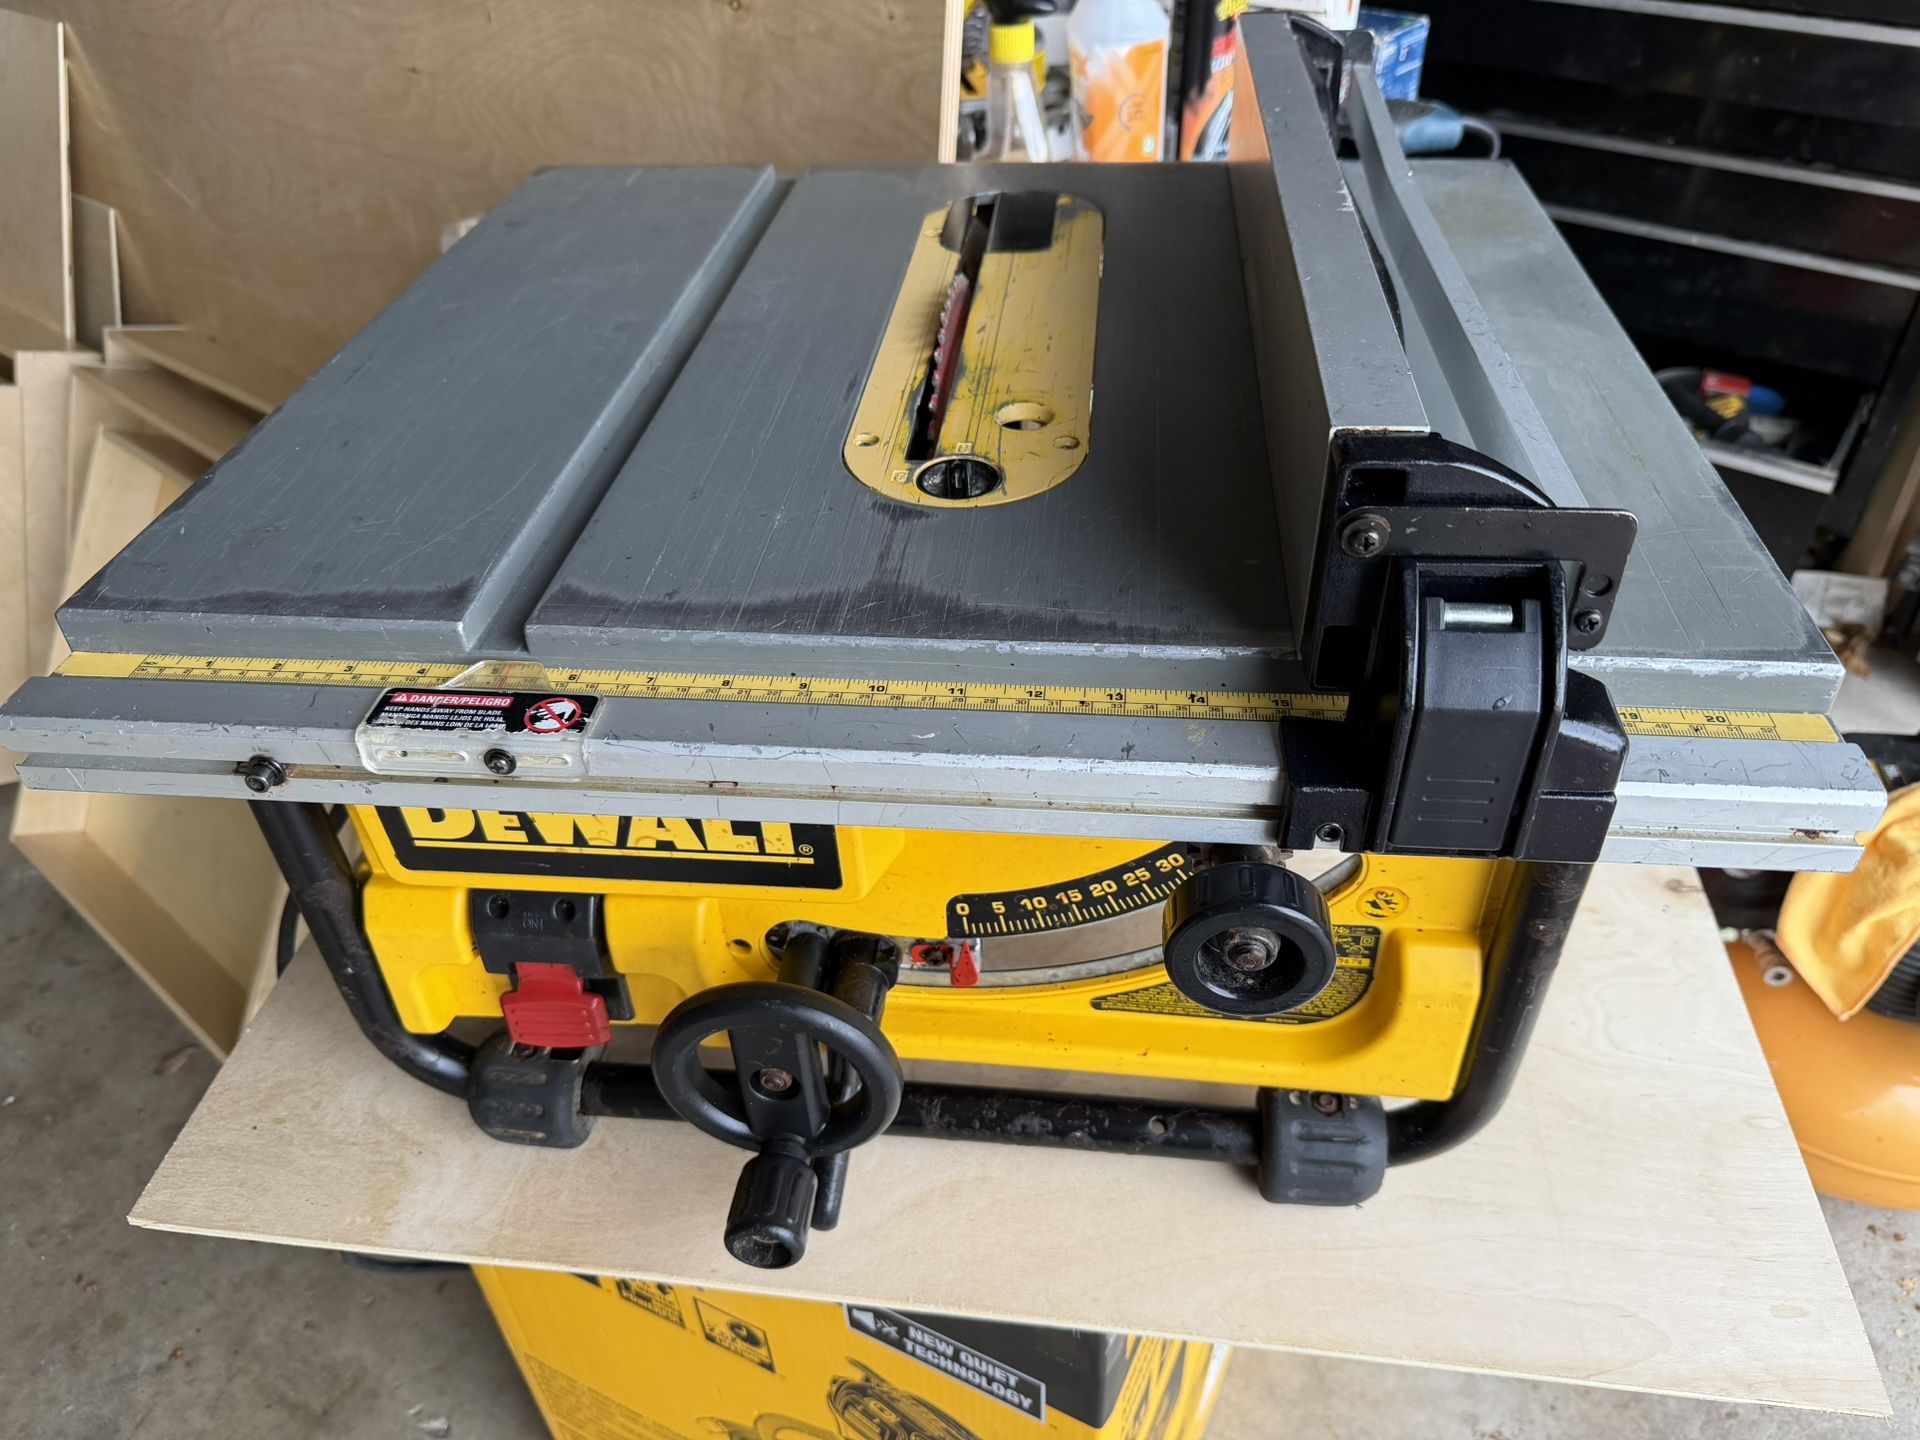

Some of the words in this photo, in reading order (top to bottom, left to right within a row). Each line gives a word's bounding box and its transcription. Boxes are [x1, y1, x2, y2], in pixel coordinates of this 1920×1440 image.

[272, 662, 282, 670] 2
[798, 682, 807, 690] 9
[1026, 690, 1043, 698] 12
[1106, 692, 1124, 700] 13
[1188, 695, 1205, 704] 14
[409, 694, 511, 707] DANGER/PELIGRO
[1620, 712, 1638, 720] 19
[1704, 715, 1726, 723] 20
[956, 902, 970, 916] 0
[992, 901, 1006, 914] 5
[1020, 896, 1048, 912] 10
[1056, 889, 1083, 905] 15
[1089, 880, 1118, 898] 20
[1122, 867, 1152, 887] 25
[1156, 853, 1184, 873] 30
[902, 1337, 1034, 1411] TECHNOLOGY
[907, 1325, 954, 1358] NEW
[959, 1350, 1018, 1387] QUIET
